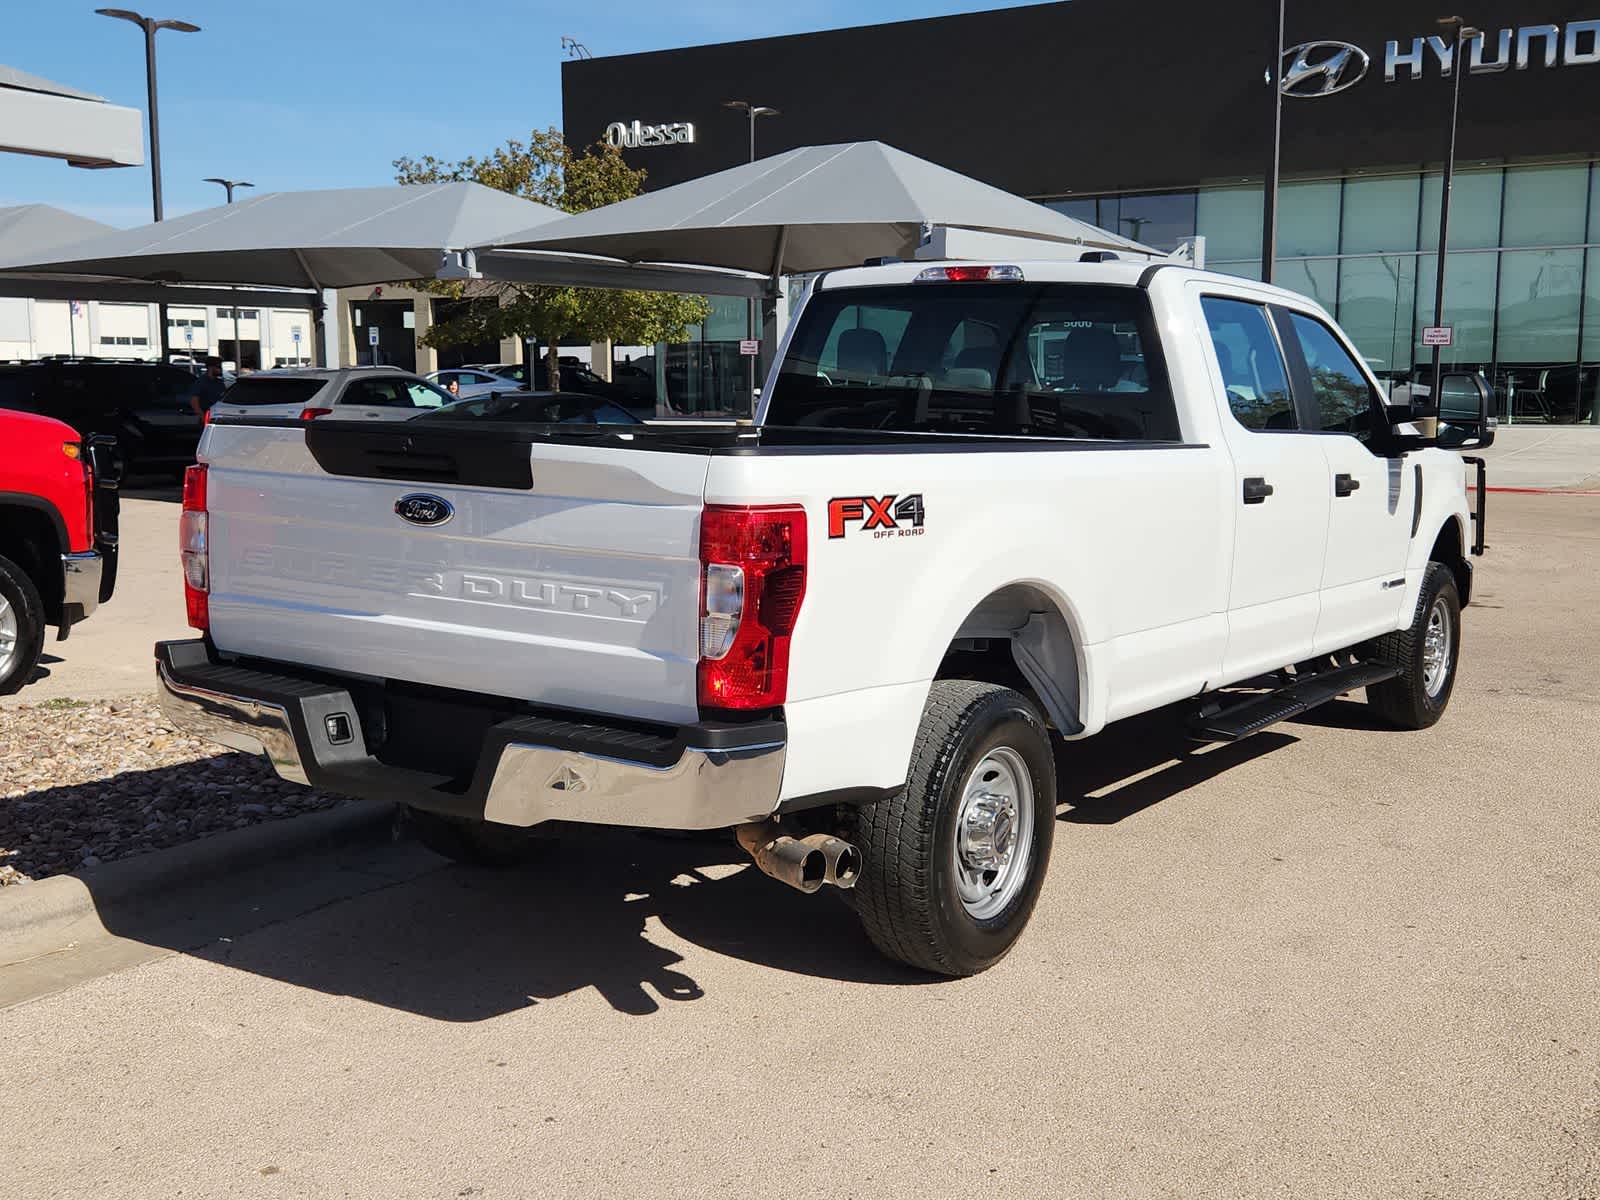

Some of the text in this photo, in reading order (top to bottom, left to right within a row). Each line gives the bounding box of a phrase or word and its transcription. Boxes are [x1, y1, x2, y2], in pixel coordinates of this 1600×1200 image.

[606, 119, 694, 148] Odessa
[405, 499, 438, 520] Ford
[827, 493, 925, 539] FX4
[873, 527, 925, 539] OFF ROAD
[463, 574, 652, 617] DUTY
